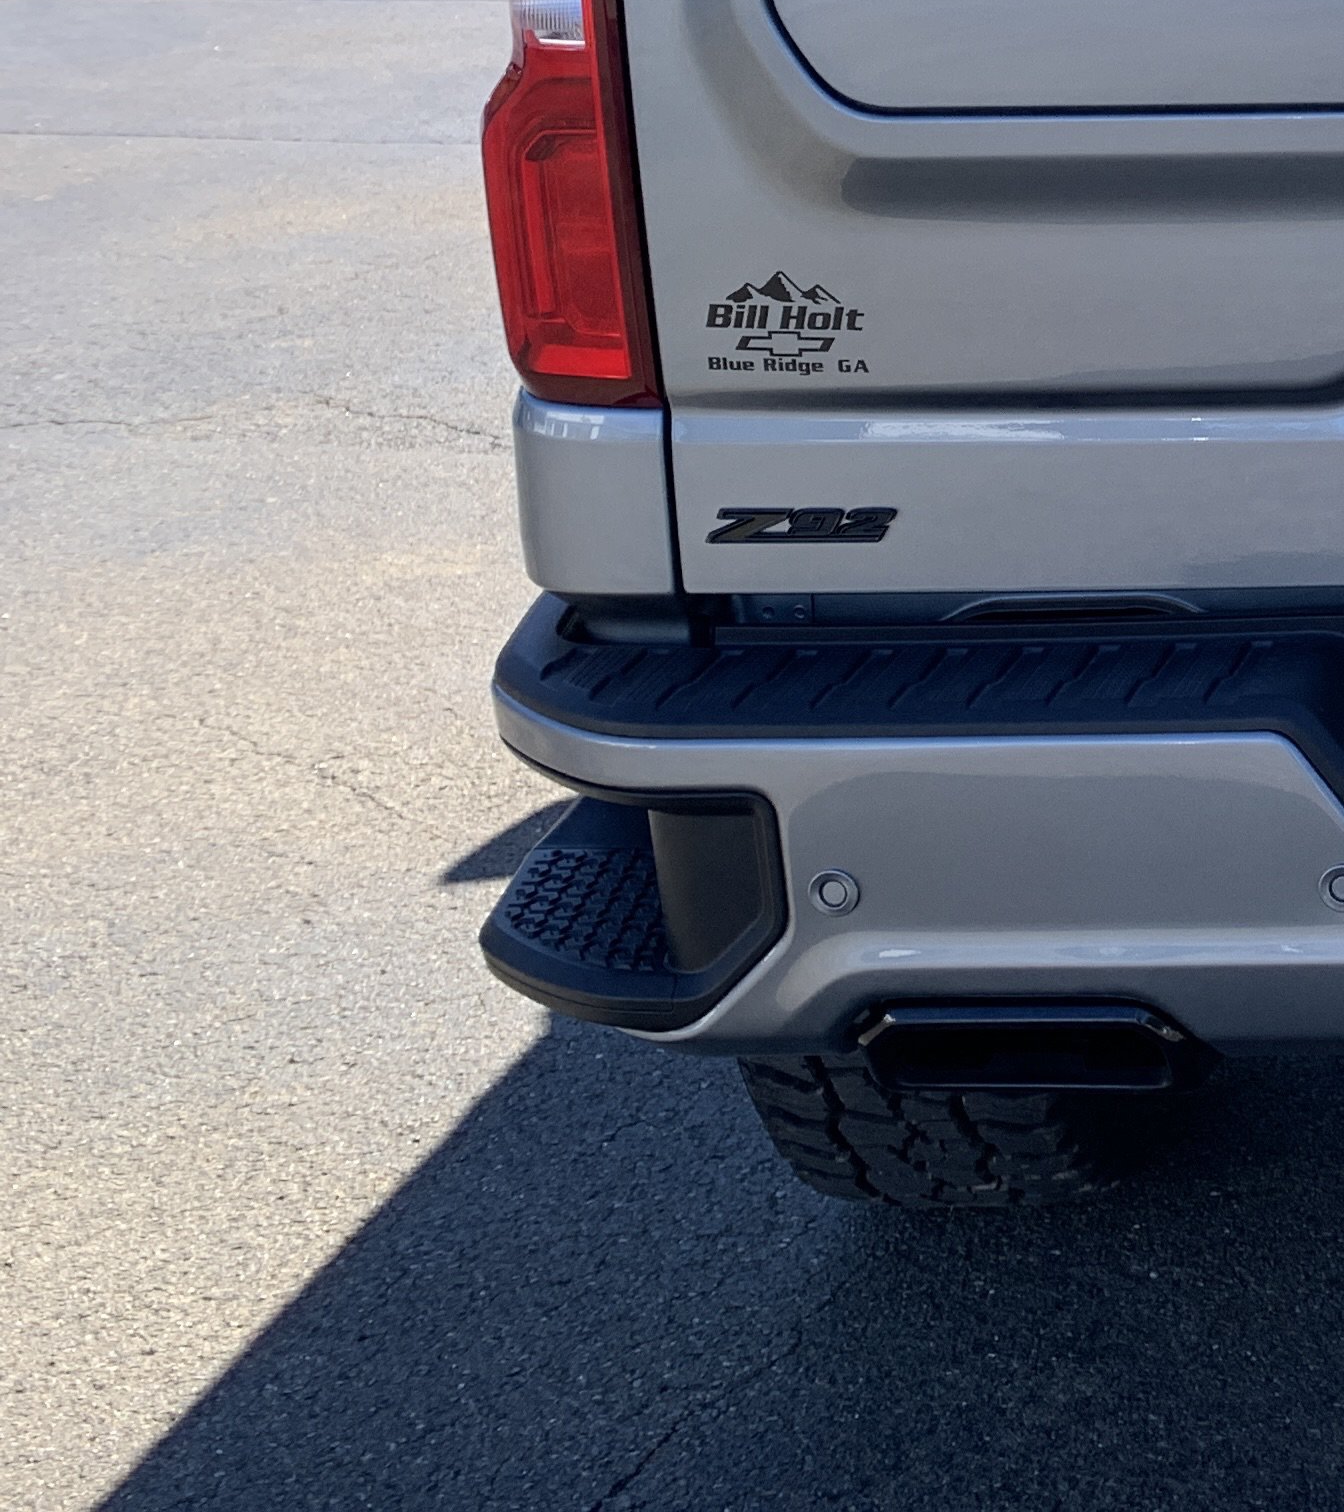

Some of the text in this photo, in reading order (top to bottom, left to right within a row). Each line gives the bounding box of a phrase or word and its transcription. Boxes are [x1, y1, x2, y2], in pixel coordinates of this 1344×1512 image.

[705, 303, 865, 331] Bill Holt
[707, 356, 869, 375] Blue Ridge GA
